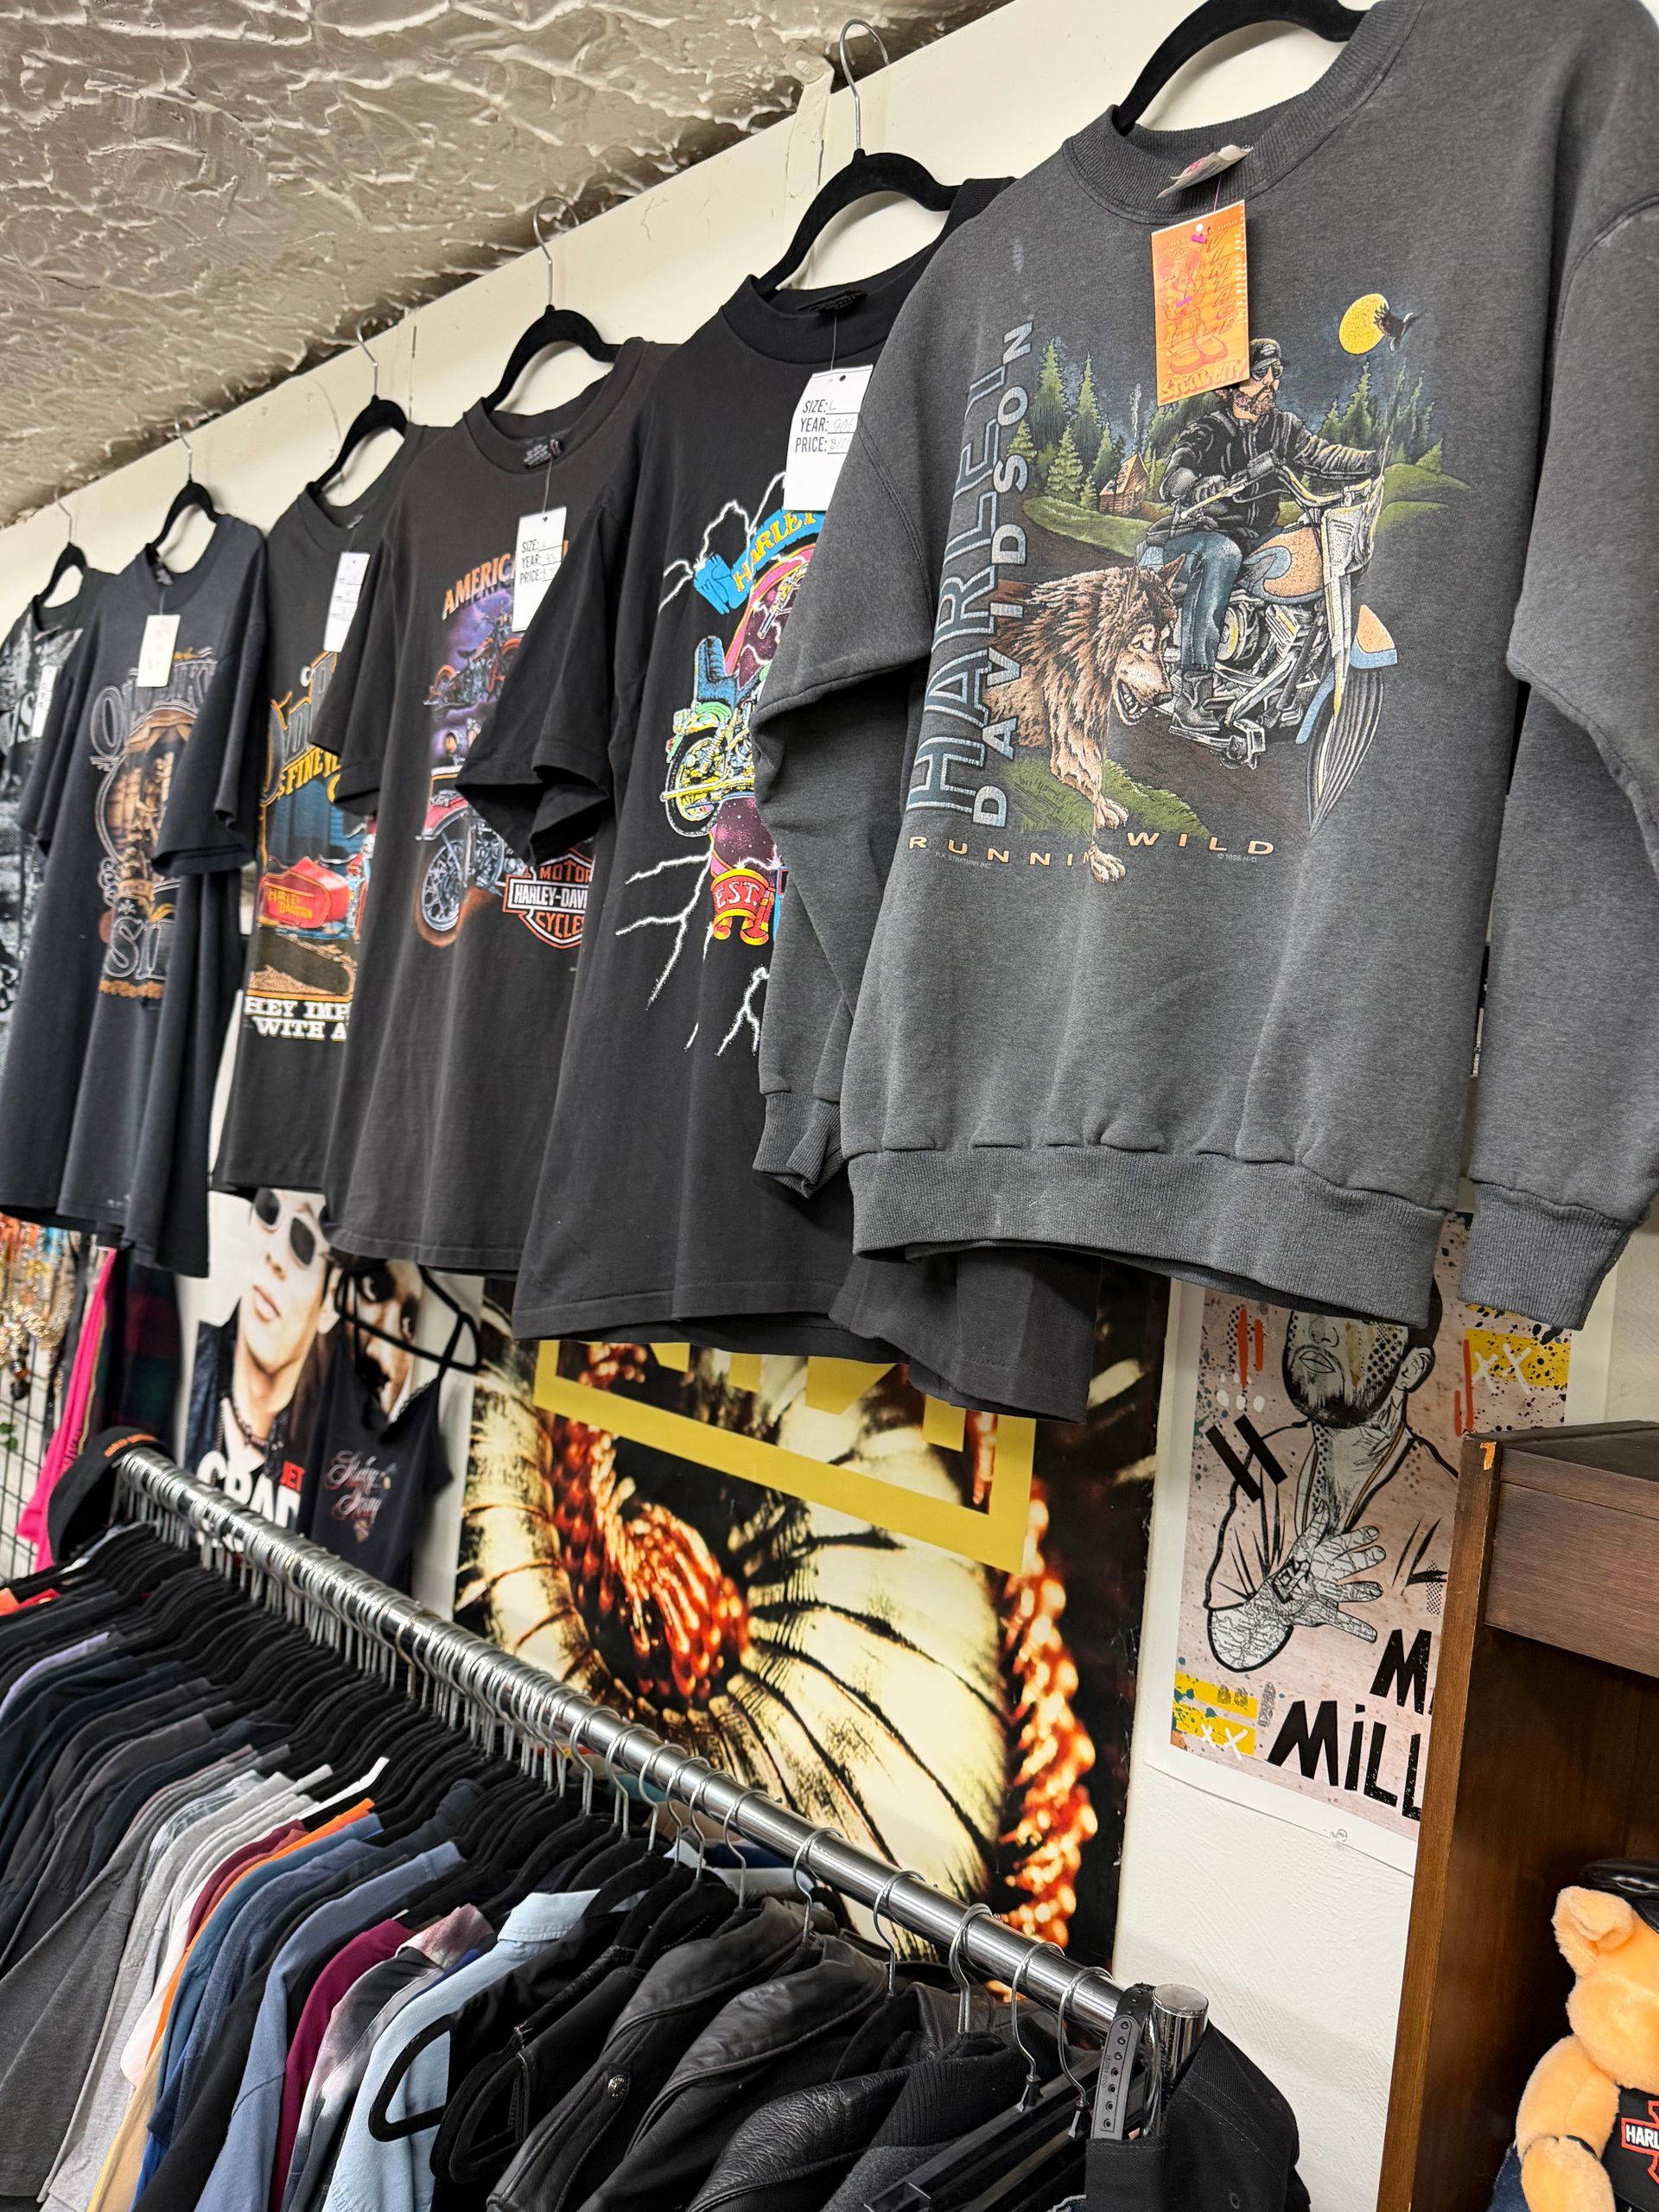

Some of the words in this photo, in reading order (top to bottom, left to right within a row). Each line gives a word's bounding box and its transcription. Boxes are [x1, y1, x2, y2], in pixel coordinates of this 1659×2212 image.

[803, 398, 828, 414] SIZE:
[800, 416, 830, 432] YEAR:
[795, 436, 828, 453] PRICE:
[521, 539, 540, 554] SIZE:
[521, 554, 543, 569] YEAR:
[519, 568, 543, 586] PRICE:
[973, 321, 1033, 827] DAVIDSON
[442, 552, 516, 621] AMERIC
[1127, 831, 1275, 855] WILD
[715, 880, 760, 909] EST.
[251, 1016, 325, 1041] WITH
